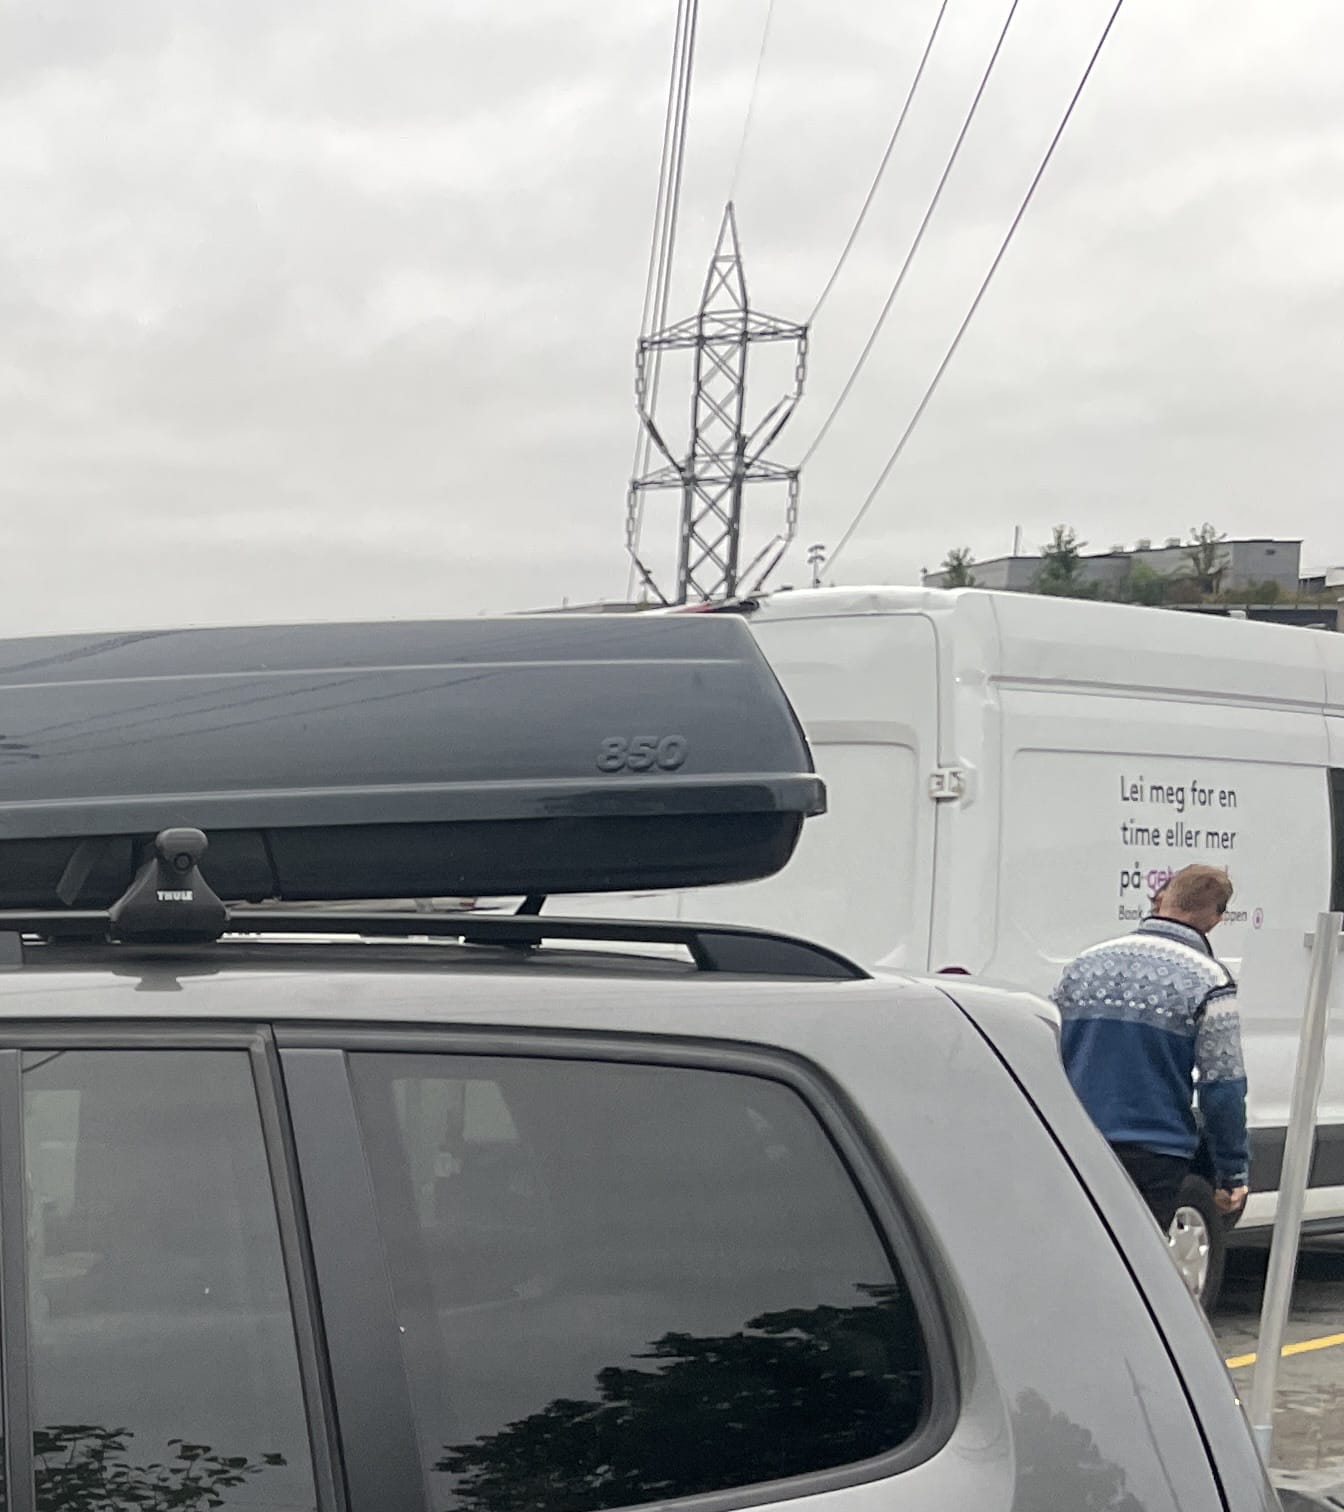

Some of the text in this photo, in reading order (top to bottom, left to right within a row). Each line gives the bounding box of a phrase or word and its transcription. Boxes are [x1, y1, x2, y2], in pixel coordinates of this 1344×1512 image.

[597, 735, 688, 772] 850
[1119, 775, 1237, 813] Lei meg for en
[1120, 818, 1236, 849] time eller mer
[156, 890, 193, 901] THULE
[1119, 861, 1141, 897] på
